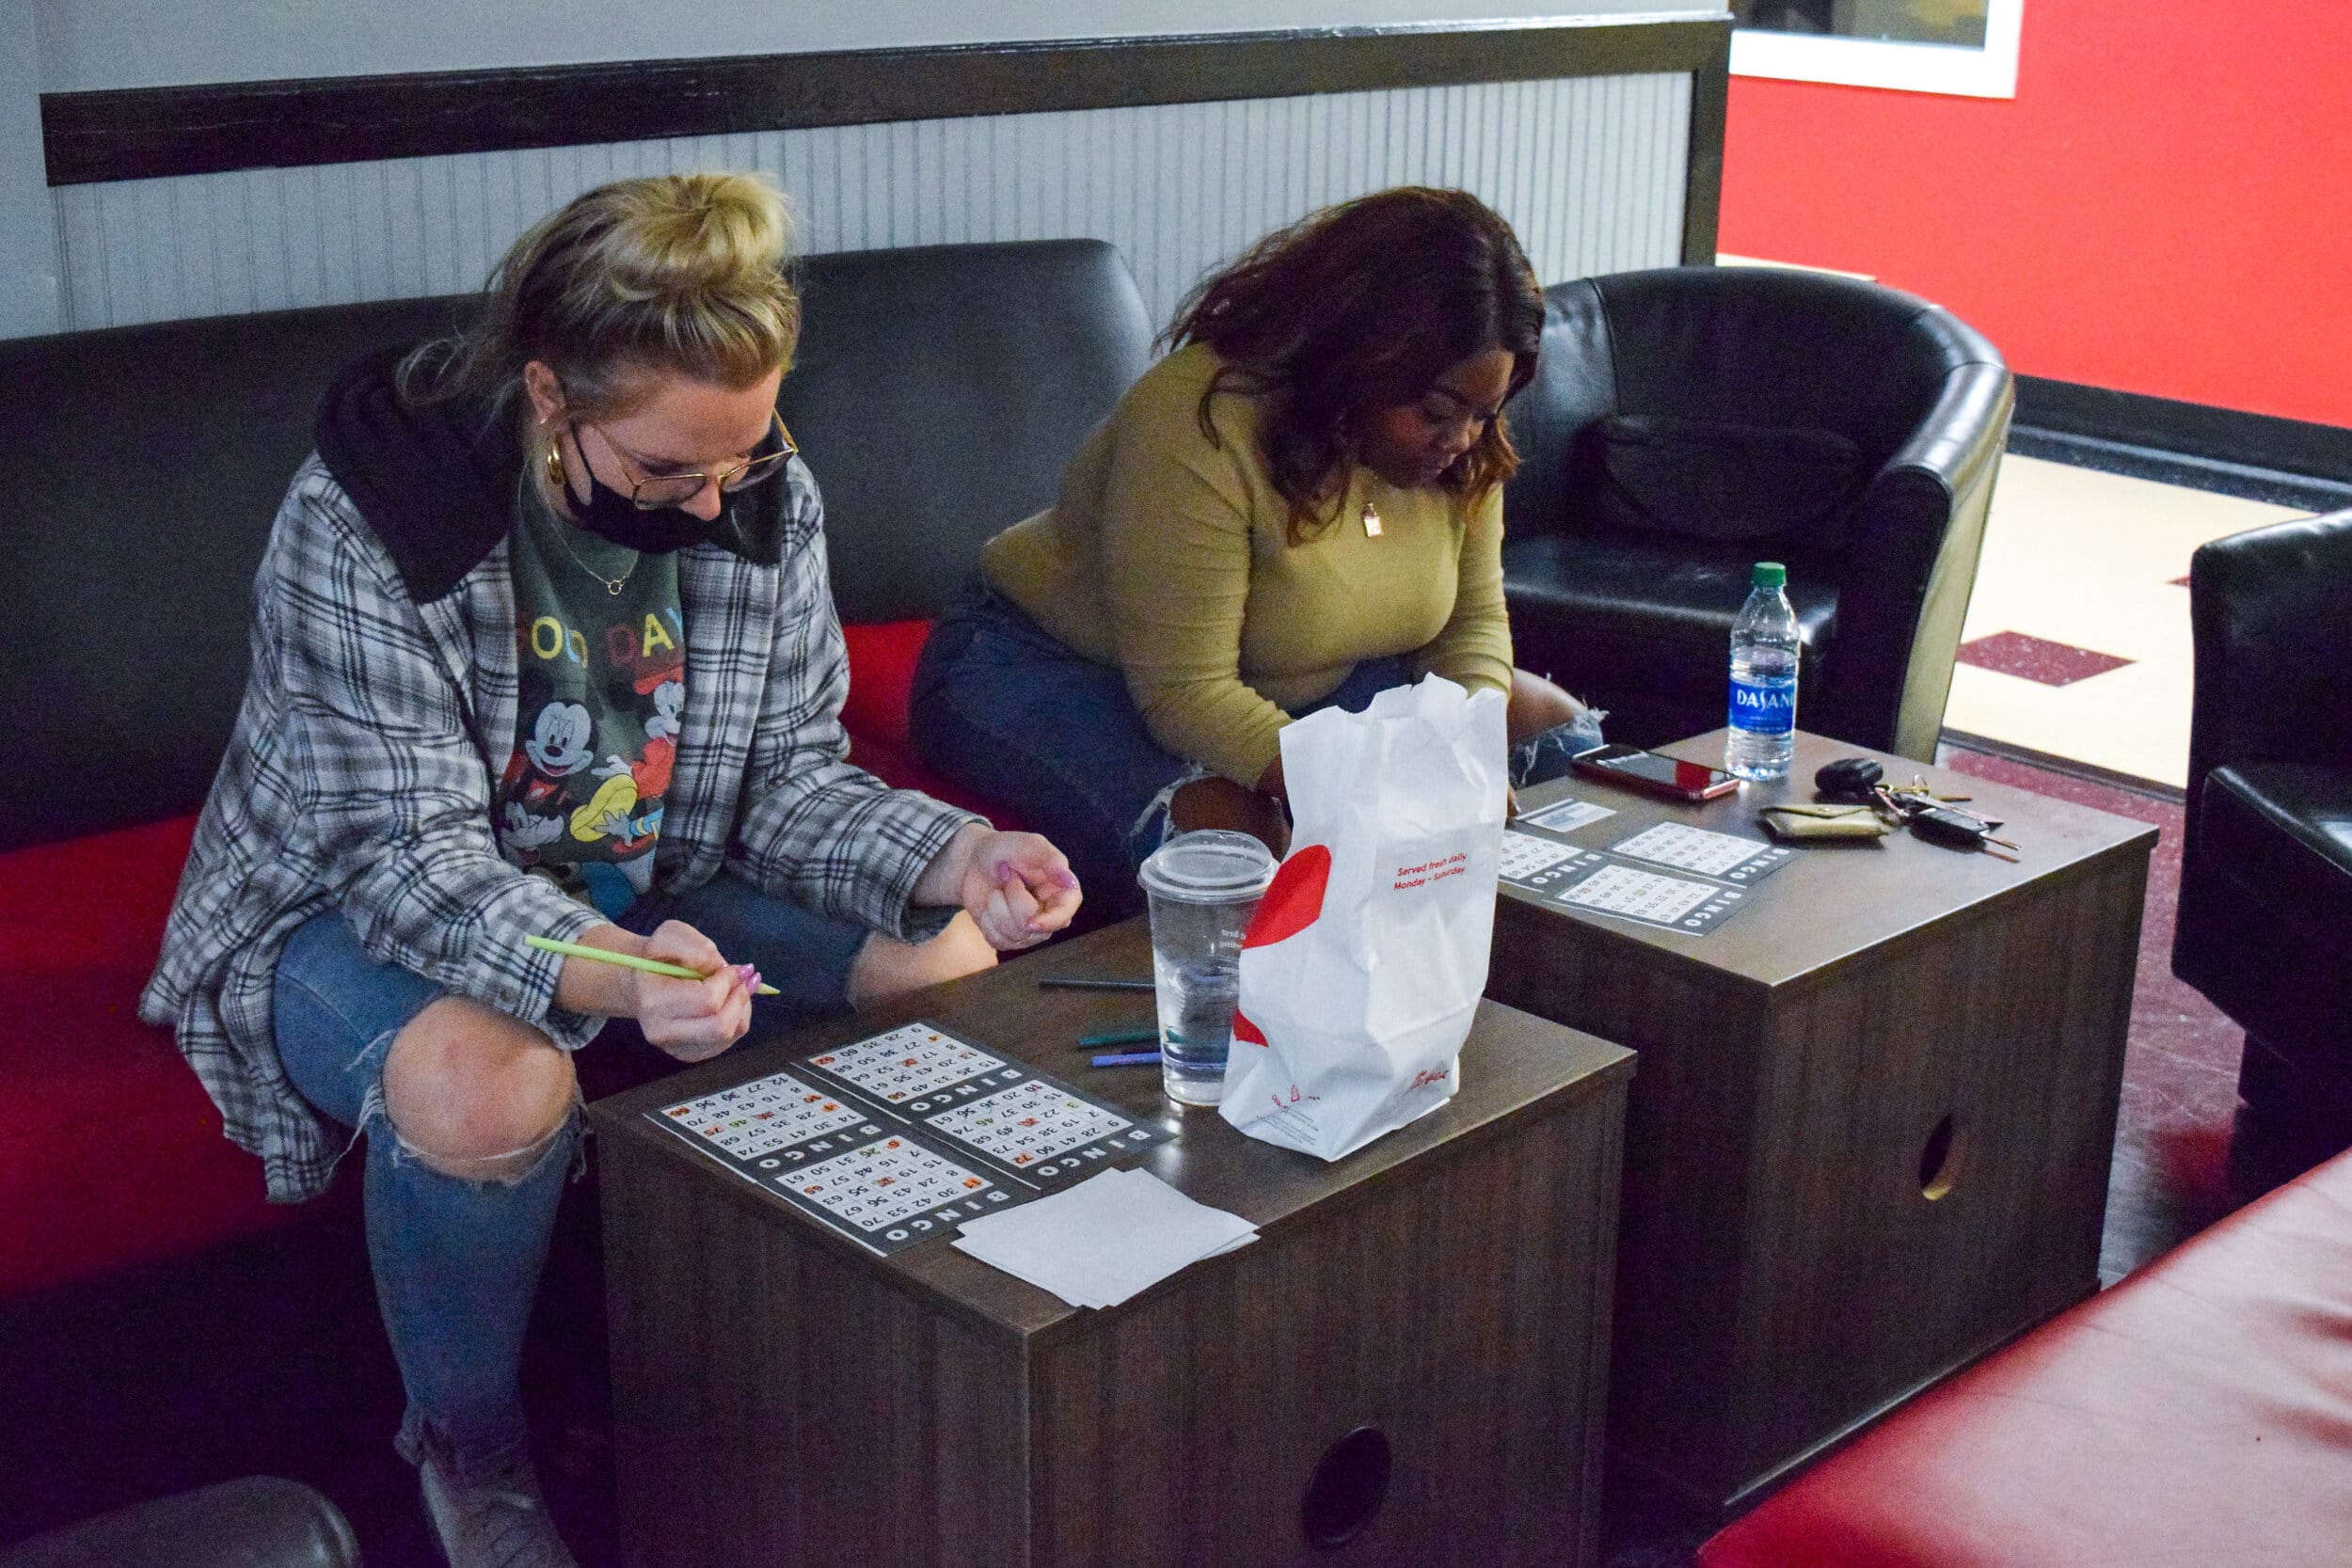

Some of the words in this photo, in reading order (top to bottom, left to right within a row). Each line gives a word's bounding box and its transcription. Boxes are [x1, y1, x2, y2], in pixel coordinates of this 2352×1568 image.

[1397, 863, 1427, 877] Served
[1428, 858, 1447, 870] fresh
[1448, 852, 1468, 864] daily
[1730, 848, 1789, 878] BINGO
[1532, 853, 1602, 884] BINGO
[1393, 879, 1425, 890] Monday
[1433, 866, 1465, 881] Saturday
[1684, 891, 1741, 926] BINGO
[746, 1084, 764, 1092] 27
[911, 1069, 1022, 1110] BINGO
[778, 1102, 798, 1111] 23
[979, 1100, 998, 1108] 36
[1041, 1109, 1059, 1117] 22
[686, 1117, 707, 1126] 70
[771, 1119, 790, 1128] 35
[813, 1121, 832, 1130] 30
[747, 1128, 766, 1136] 57
[788, 1130, 807, 1138] 41
[1081, 1128, 1100, 1136] 28
[720, 1136, 740, 1145] 68
[763, 1138, 783, 1147] 53
[1015, 1136, 1035, 1145] 54
[1058, 1136, 1077, 1145] 41
[759, 1124, 881, 1167] BINGO
[993, 1145, 1012, 1153] 73
[1035, 1146, 1056, 1154] 60
[737, 1147, 757, 1155] 74
[1038, 1130, 1151, 1175] BINGO
[835, 1157, 855, 1165] 31
[879, 1158, 898, 1166] 16
[922, 1159, 942, 1167] 15
[810, 1165, 831, 1174] 50
[785, 1175, 804, 1183] 61
[830, 1176, 850, 1184] 57
[917, 1178, 938, 1186] 24
[893, 1187, 912, 1196] 43
[937, 1188, 958, 1196] 30
[821, 1196, 843, 1204] 63
[866, 1196, 888, 1206] 56
[912, 1197, 931, 1206] 42
[842, 1206, 862, 1215] 67
[886, 1207, 908, 1216] 53
[886, 1191, 1009, 1240] BINGO
[861, 1217, 882, 1226] 70
